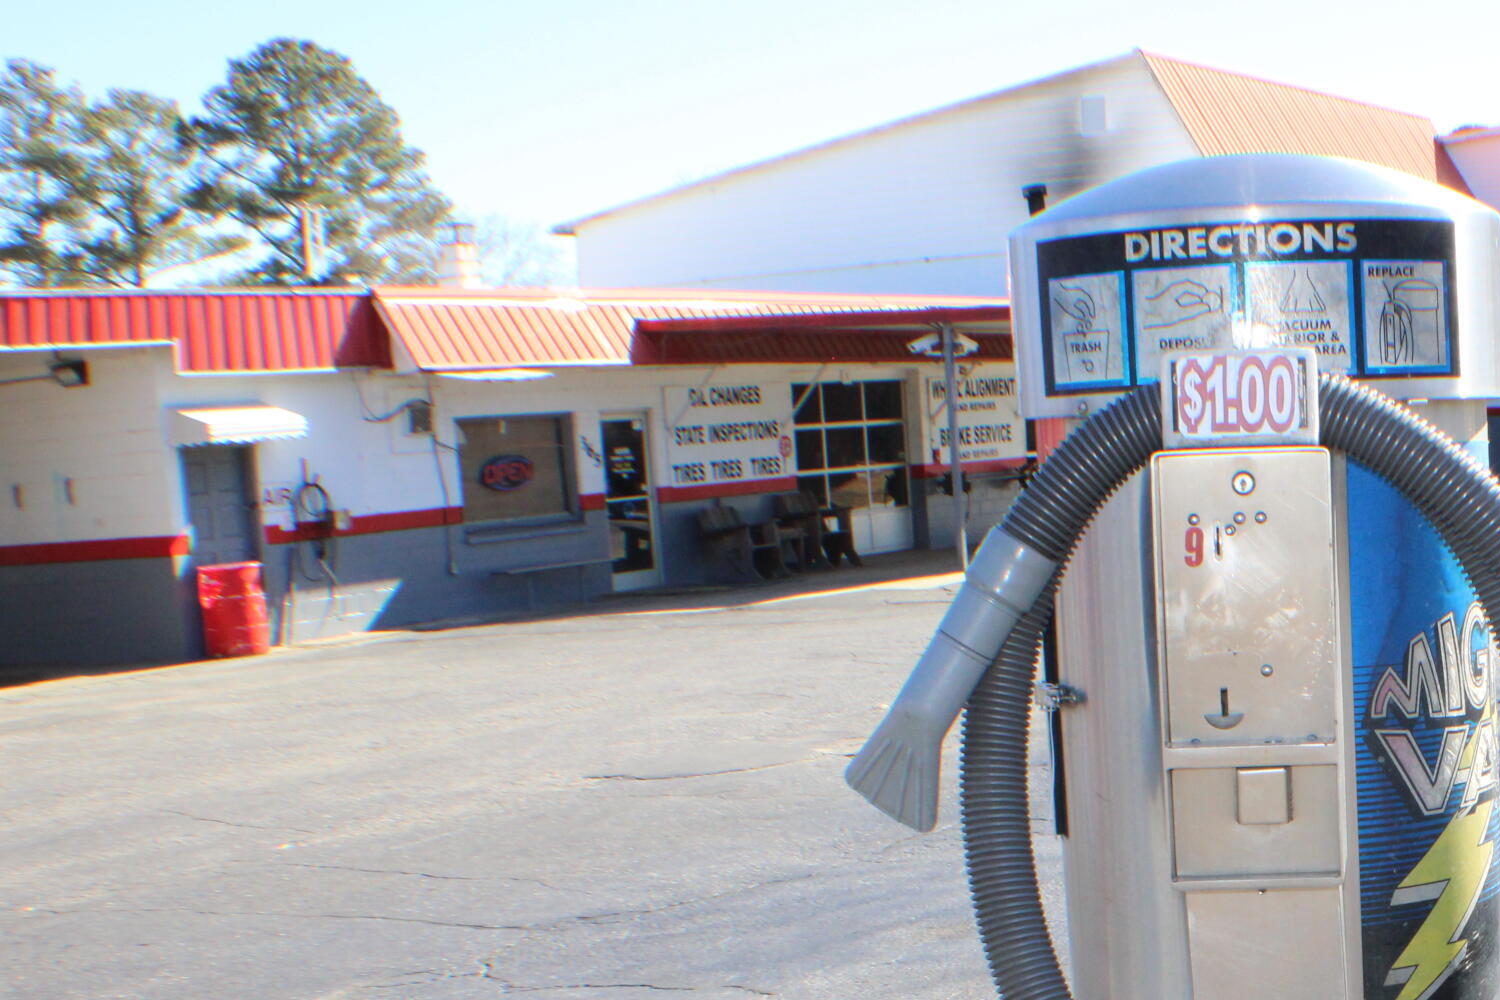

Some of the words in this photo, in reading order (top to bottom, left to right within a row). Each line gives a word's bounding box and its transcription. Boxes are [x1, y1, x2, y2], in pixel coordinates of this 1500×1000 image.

[1124, 221, 1357, 263] DIRECTIONS
[1367, 266, 1415, 277] REPLACE
[1281, 319, 1332, 331] ACUUM
[1331, 331, 1340, 342] &
[1070, 341, 1102, 355] TRASH
[709, 385, 762, 405] CHANGES
[964, 377, 1016, 397] ALIGNMENT
[1179, 356, 1296, 434] $1.00
[674, 426, 706, 446] STATE
[707, 420, 780, 443] INSPECTIONS
[973, 424, 1012, 444] SERVICE
[672, 463, 706, 483] TIRES
[709, 459, 743, 480] TIRES
[750, 456, 782, 476] TIRES
